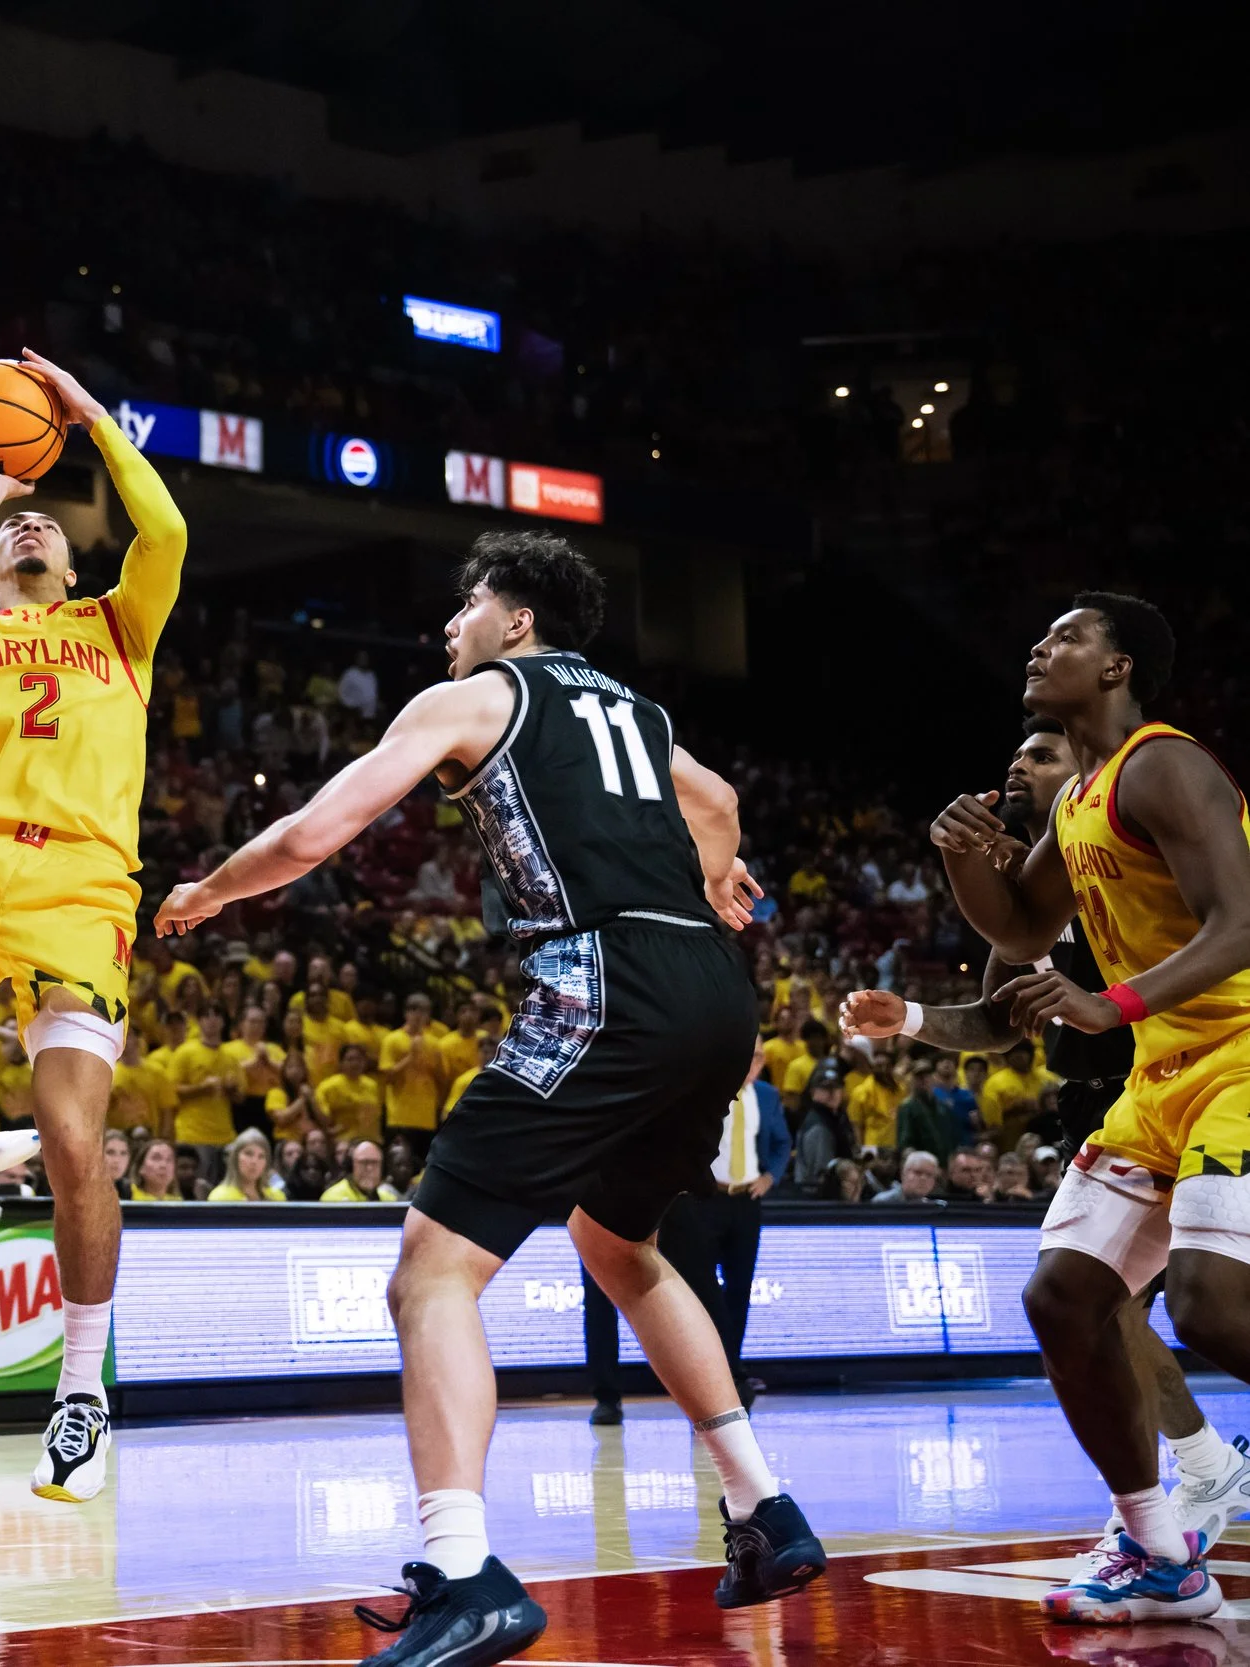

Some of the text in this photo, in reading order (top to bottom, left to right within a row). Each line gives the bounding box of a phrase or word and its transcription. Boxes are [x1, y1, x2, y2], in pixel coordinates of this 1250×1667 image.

[216, 414, 247, 466] M
[464, 453, 599, 508] M TOYOTA
[543, 663, 636, 701] HALAIFONUA
[19, 672, 60, 739] 2
[569, 691, 662, 801] 11
[316, 1267, 388, 1299] BUD
[906, 1260, 962, 1289] BUD
[897, 1287, 975, 1318] LIGHT
